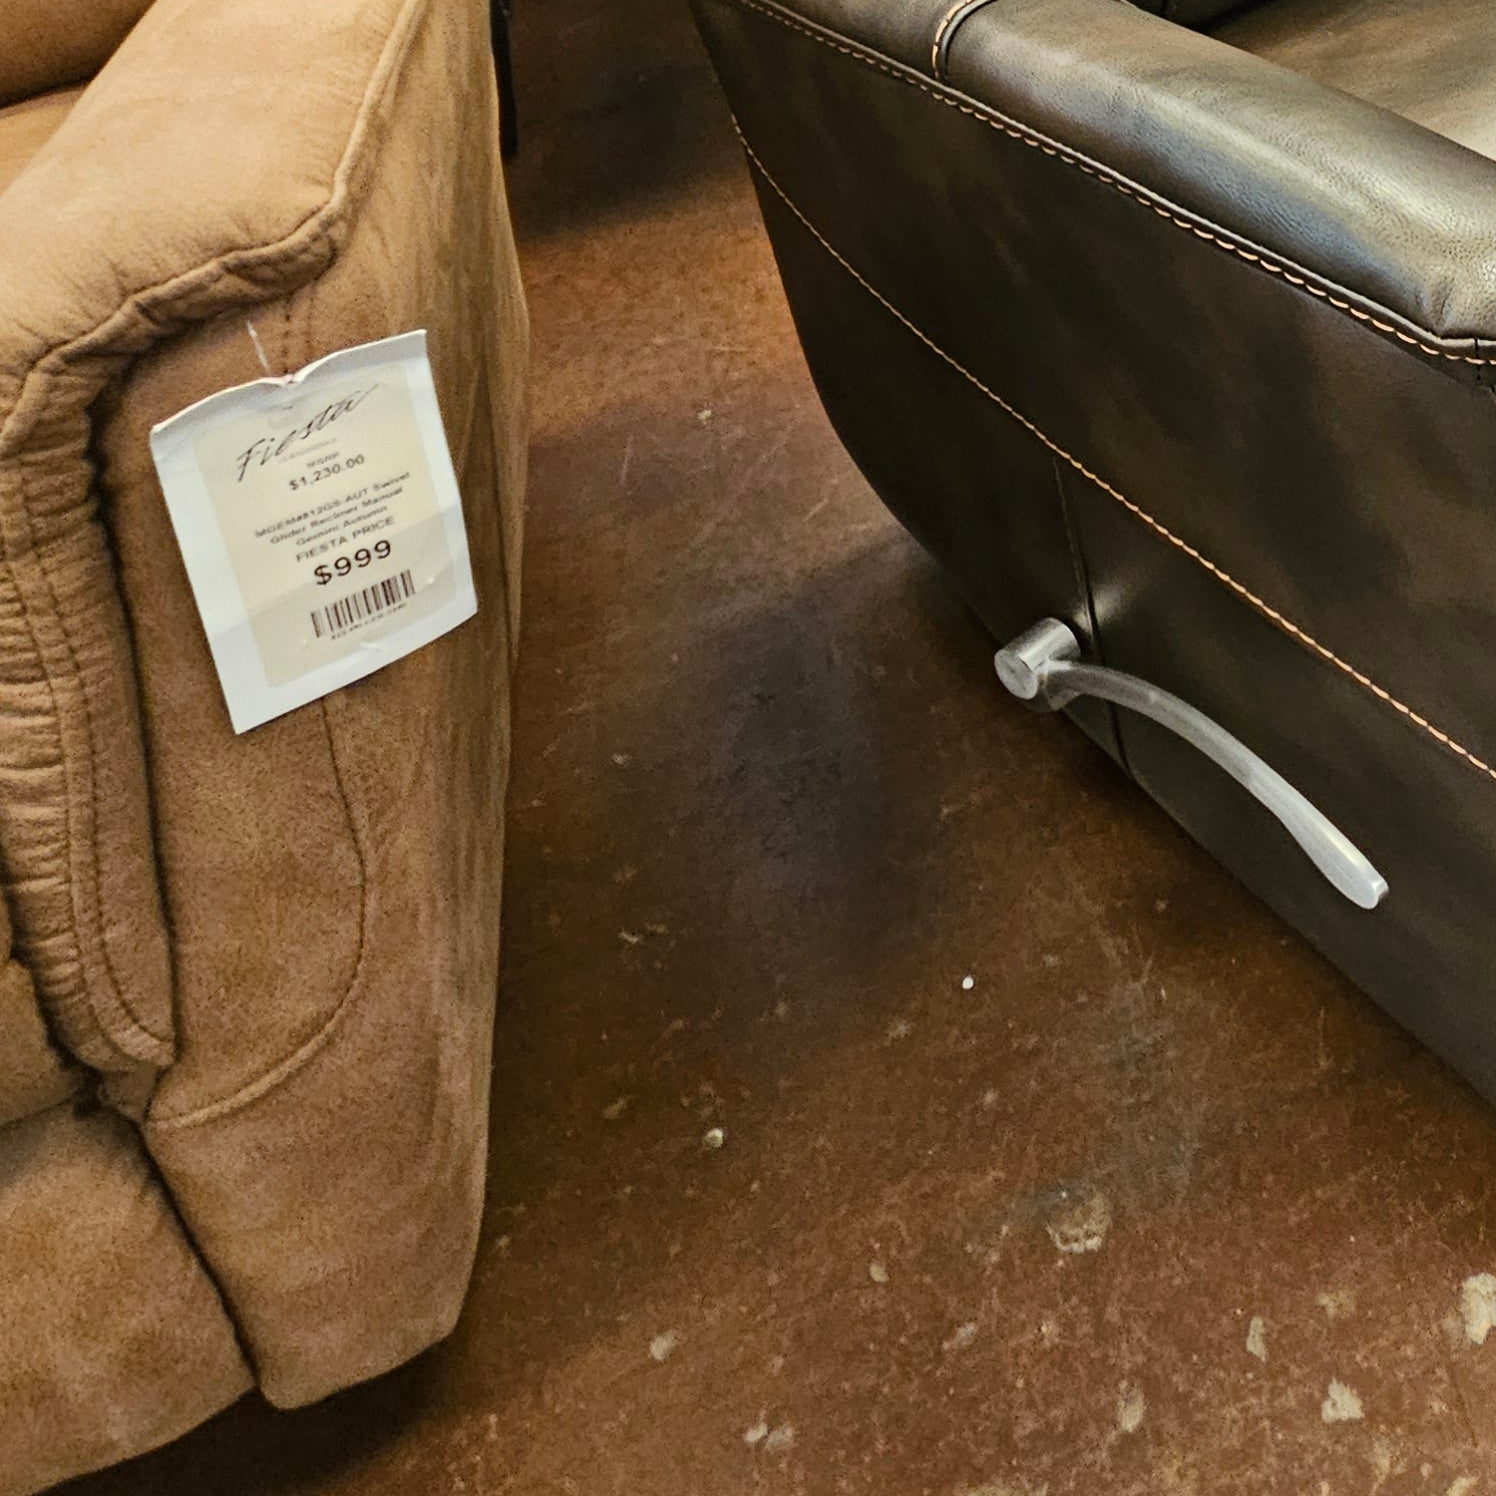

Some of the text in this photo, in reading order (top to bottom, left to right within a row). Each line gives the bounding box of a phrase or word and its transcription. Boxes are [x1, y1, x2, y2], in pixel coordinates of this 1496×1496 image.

[236, 384, 381, 481] Fiesta
[289, 454, 365, 491] $1,230.00
[373, 471, 410, 491] Swivel
[270, 487, 403, 544] Glider Recliner Manual
[296, 506, 388, 545] Gemini Autumn
[296, 515, 395, 563] FIESTA PRICE
[313, 539, 392, 587] $999
